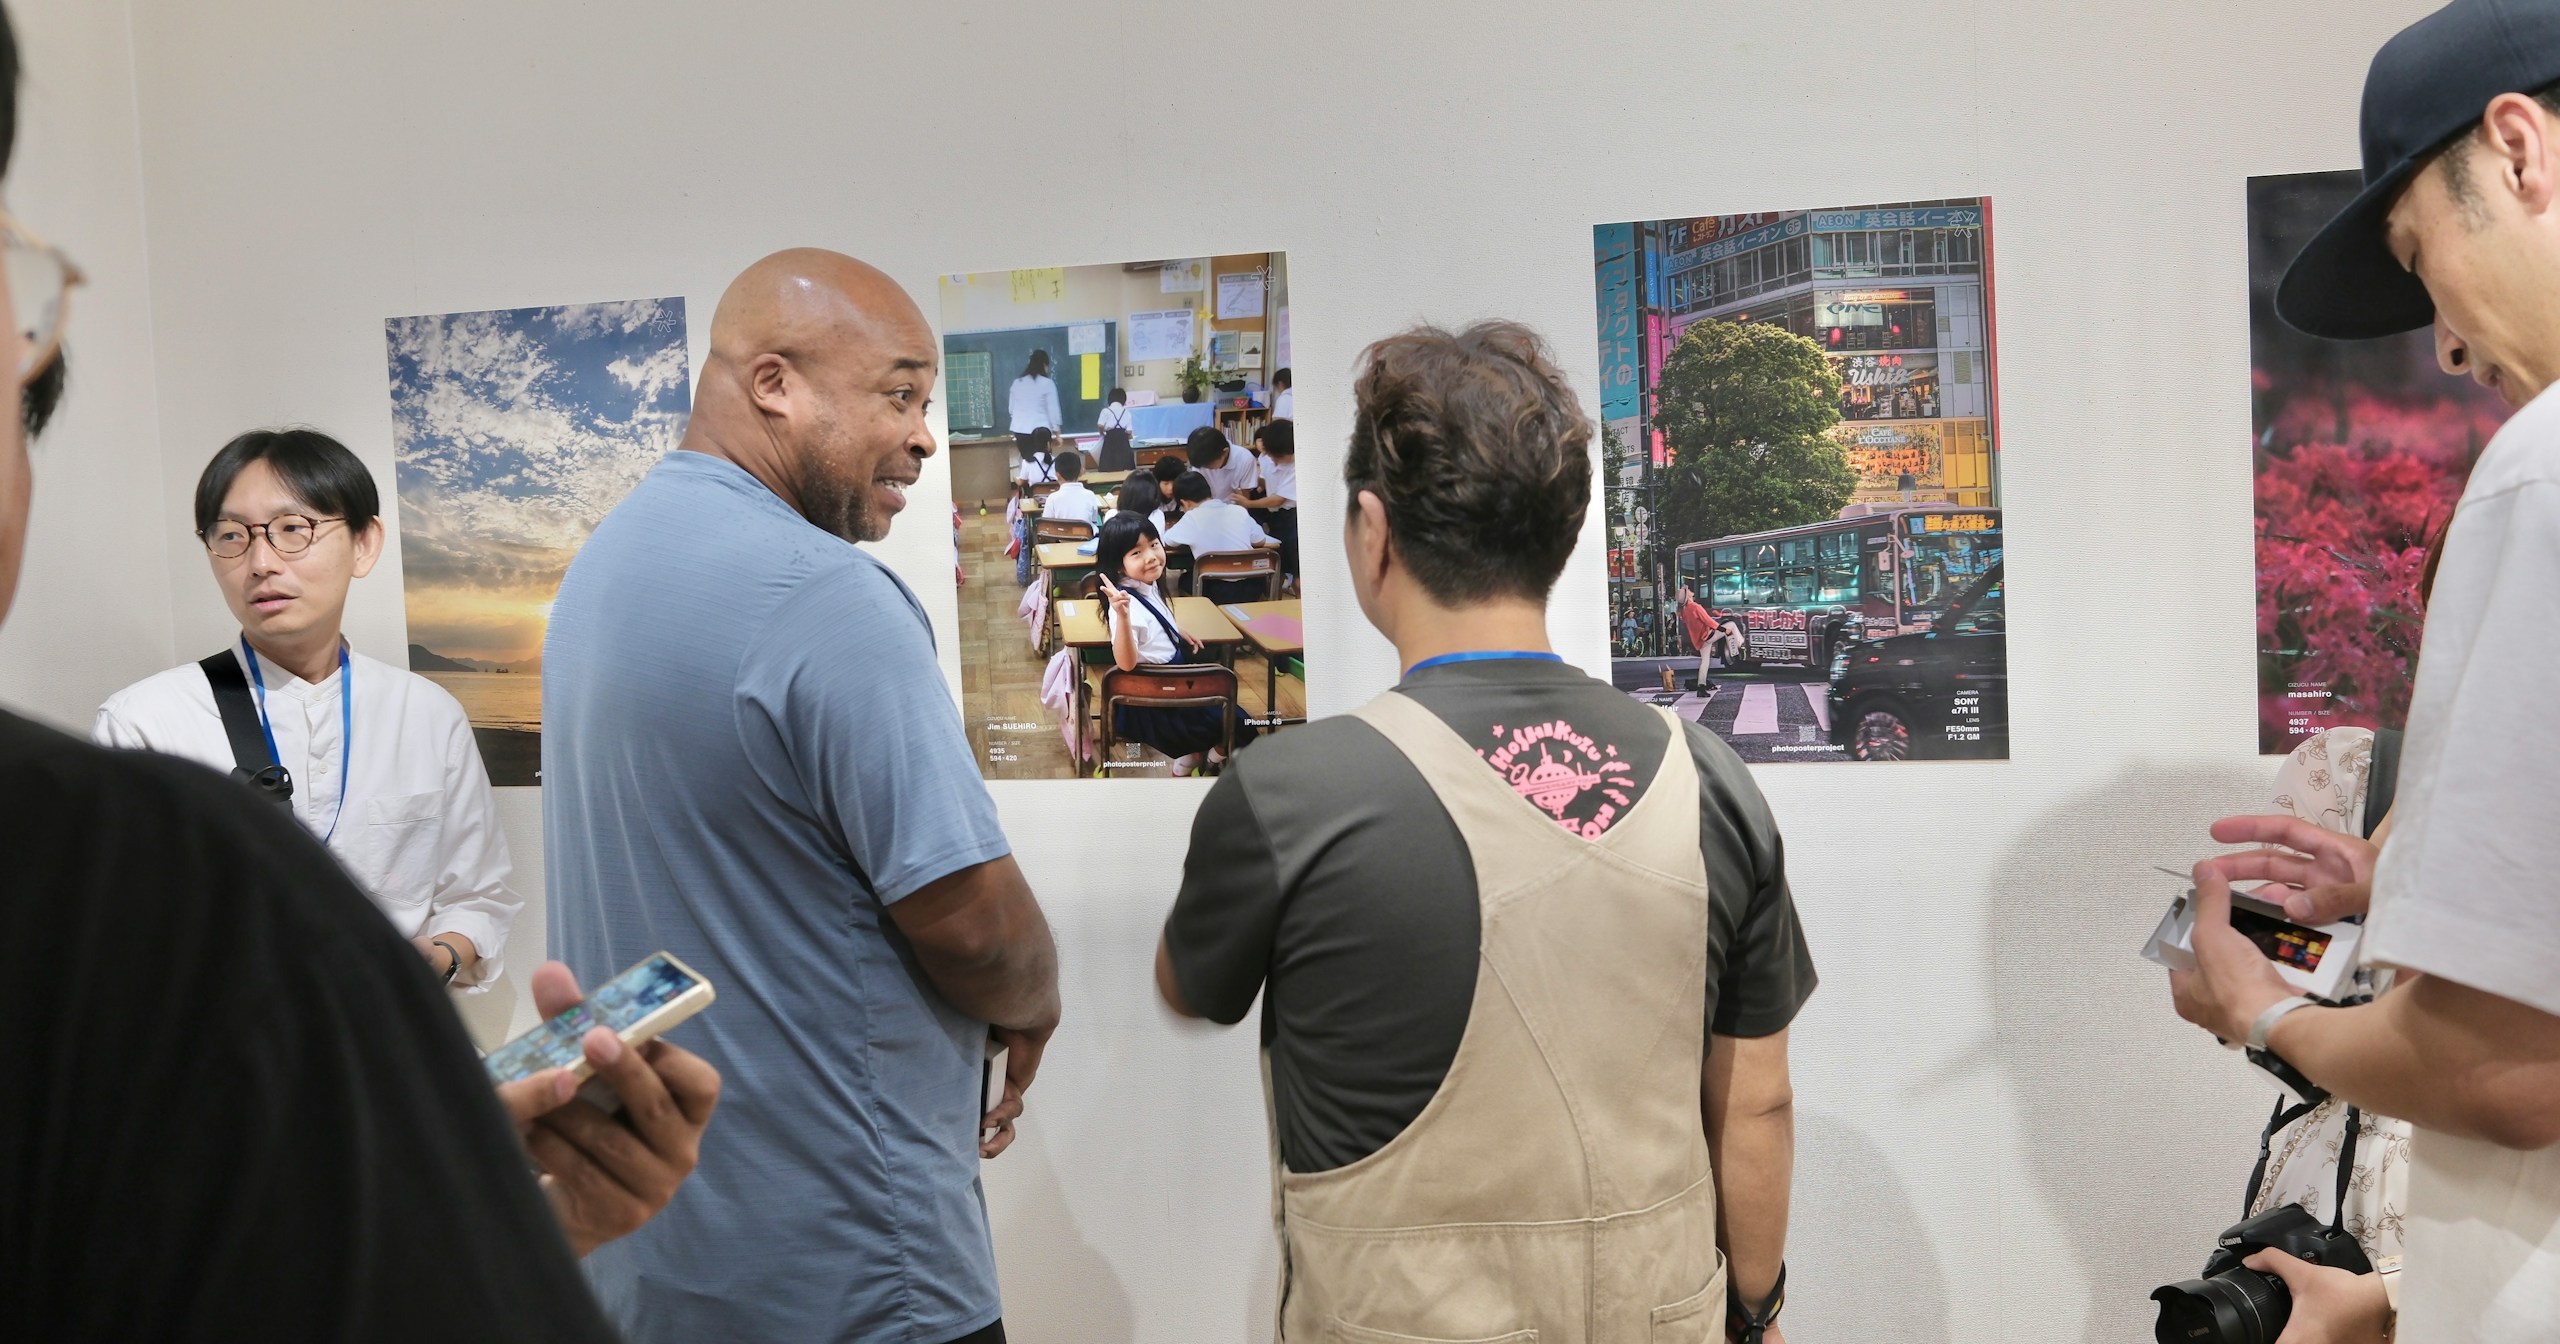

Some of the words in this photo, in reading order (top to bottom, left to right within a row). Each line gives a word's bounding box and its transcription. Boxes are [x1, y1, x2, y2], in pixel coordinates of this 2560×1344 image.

[1818, 214, 1854, 227] AEON
[1668, 225, 1687, 247] 7F
[1668, 254, 1693, 270] AEON
[1701, 227, 1781, 262] 英会話イーオン
[1612, 241, 1633, 386] コンタクトの
[2287, 690, 2332, 698] masahiro
[1953, 697, 1979, 706] SONY
[1970, 706, 1979, 714] III
[1002, 722, 1037, 730] SUEHIRO
[1244, 718, 1270, 726] iPhone
[1271, 717, 1282, 725] 4S
[1945, 725, 1980, 733] FE50mm
[1947, 733, 1965, 741] F1.2
[1771, 743, 1845, 753] photoposterproject
[1103, 760, 1166, 768] photoposterproject
[2220, 1236, 2242, 1247] Canon
[2187, 1326, 2210, 1339] Canon
